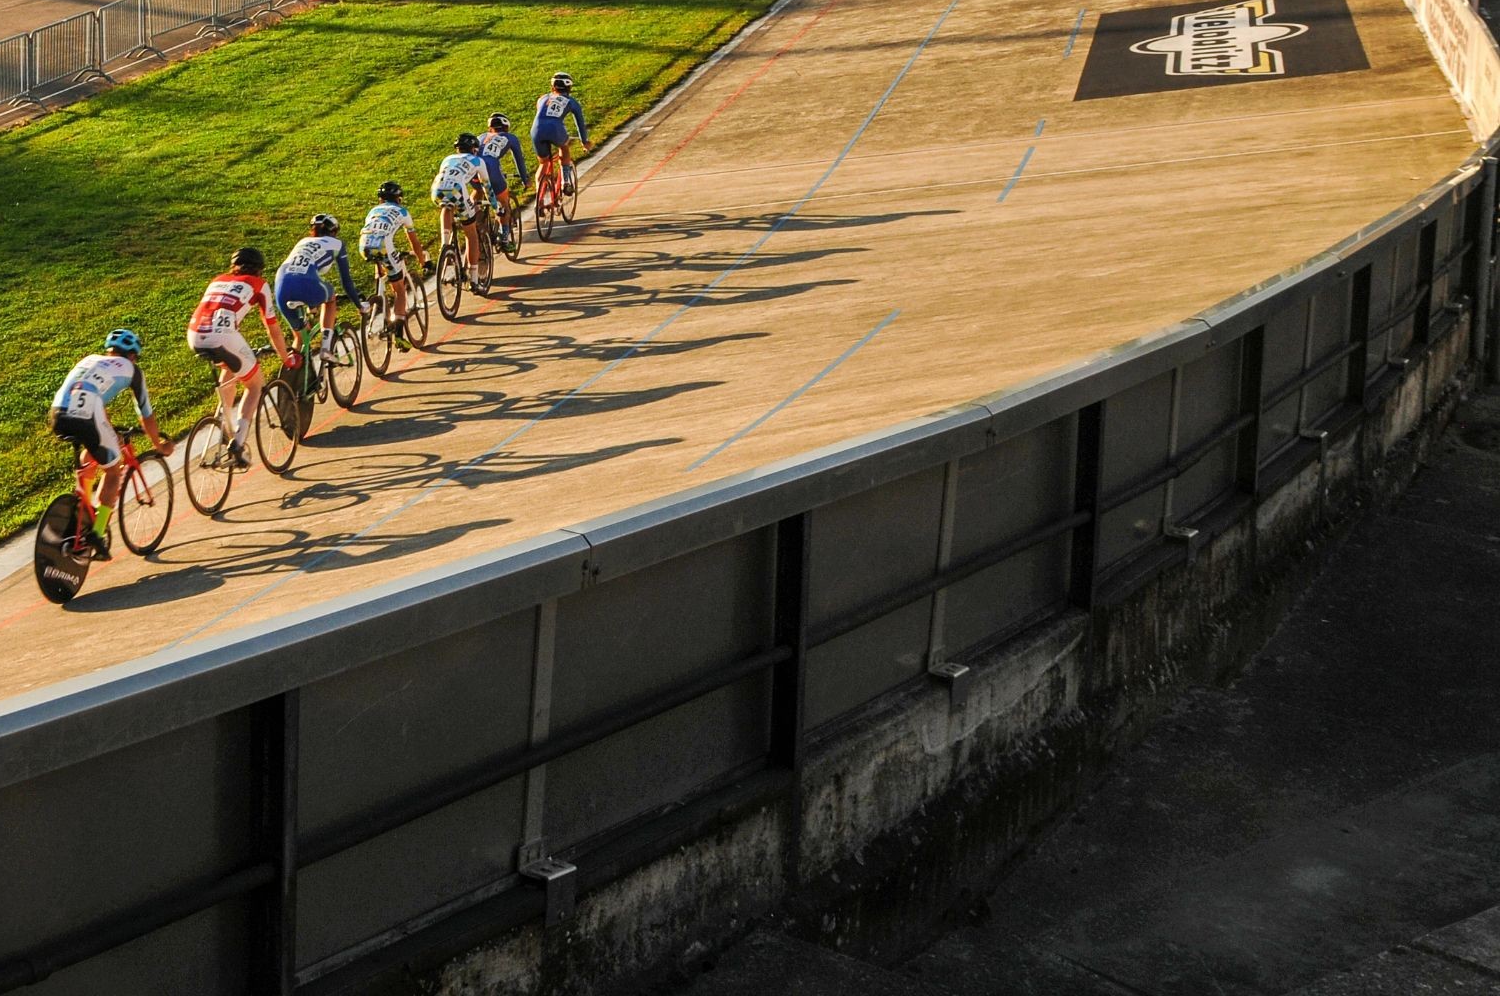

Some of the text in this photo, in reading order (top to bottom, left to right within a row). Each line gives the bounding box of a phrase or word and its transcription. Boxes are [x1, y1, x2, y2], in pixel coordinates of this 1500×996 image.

[550, 104, 561, 112] 45
[487, 144, 497, 152] 41
[291, 255, 310, 267] 135
[218, 316, 230, 327] 26
[77, 392, 86, 408] 5
